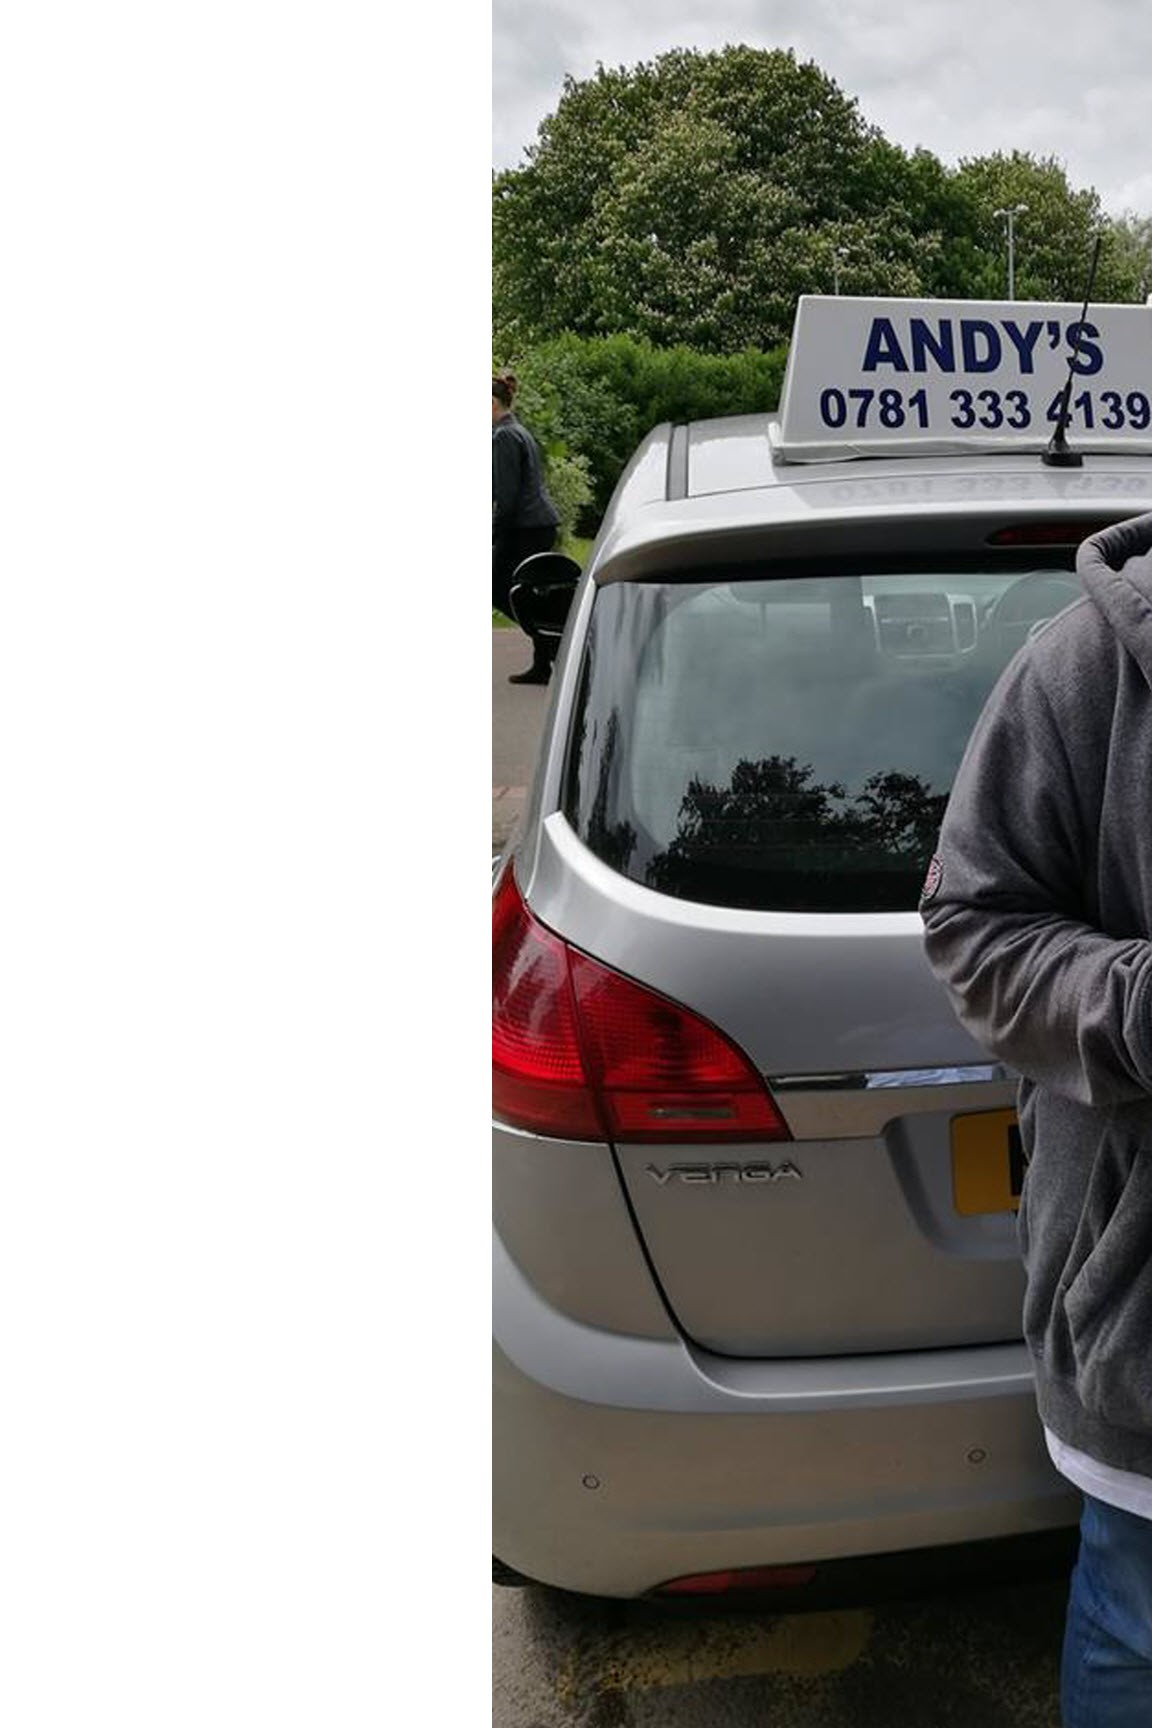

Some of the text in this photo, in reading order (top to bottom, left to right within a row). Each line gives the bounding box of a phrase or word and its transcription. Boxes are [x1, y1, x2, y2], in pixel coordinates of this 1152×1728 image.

[861, 317, 1105, 376] ANDY'S
[819, 388, 1151, 430] 0781 333 4139
[645, 1160, 803, 1185] VENGA
